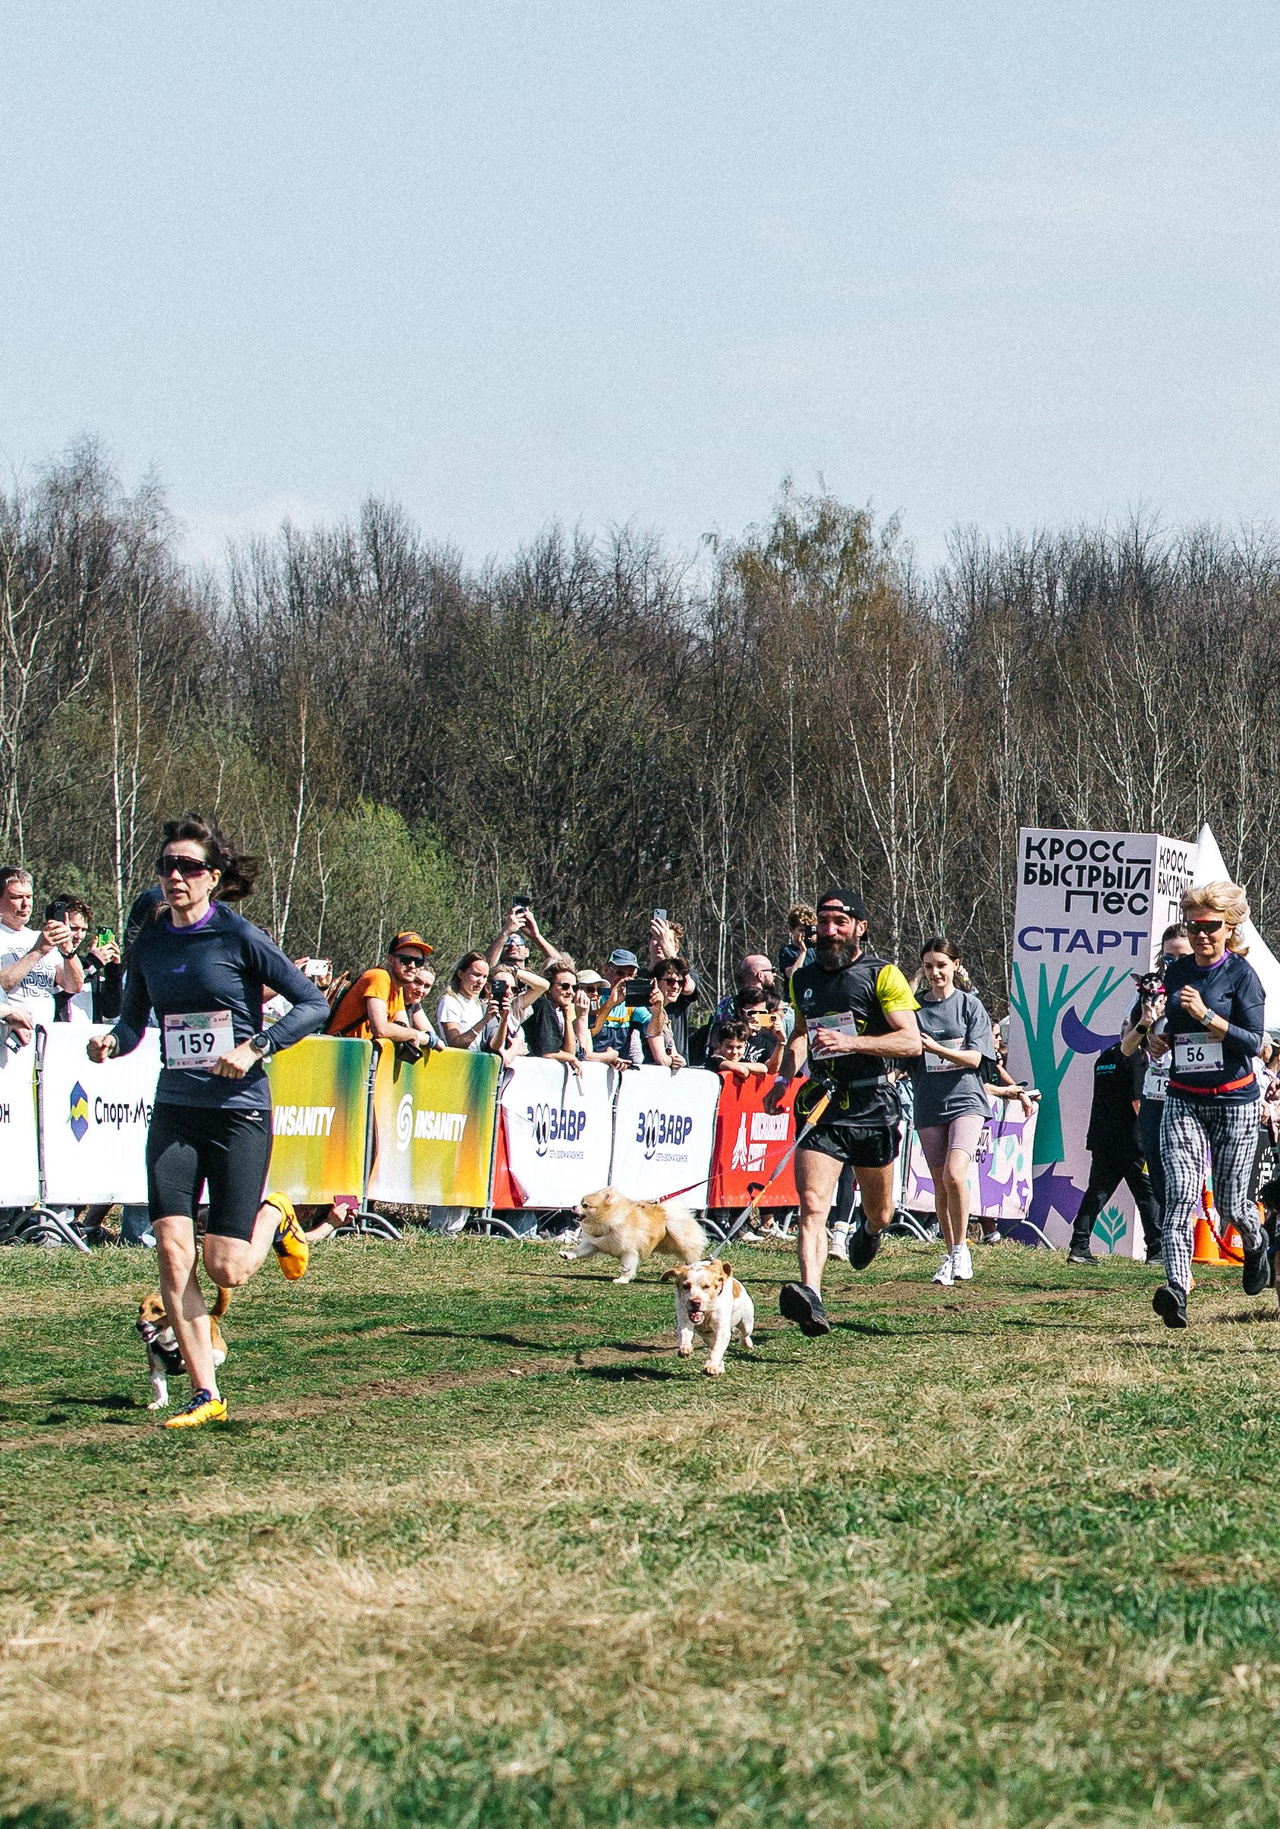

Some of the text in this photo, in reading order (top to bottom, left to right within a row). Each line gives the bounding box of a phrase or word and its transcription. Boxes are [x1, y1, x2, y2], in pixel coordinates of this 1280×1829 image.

[1023, 859, 1152, 890] БЫСТРЫЙ
[1017, 926, 1148, 956] СТАРТ
[178, 1032, 215, 1055] 159
[1186, 1046, 1205, 1063] 56
[1156, 1078, 1170, 1093] 19
[273, 1105, 336, 1136] INSANITY
[413, 1109, 468, 1142] INSANITY
